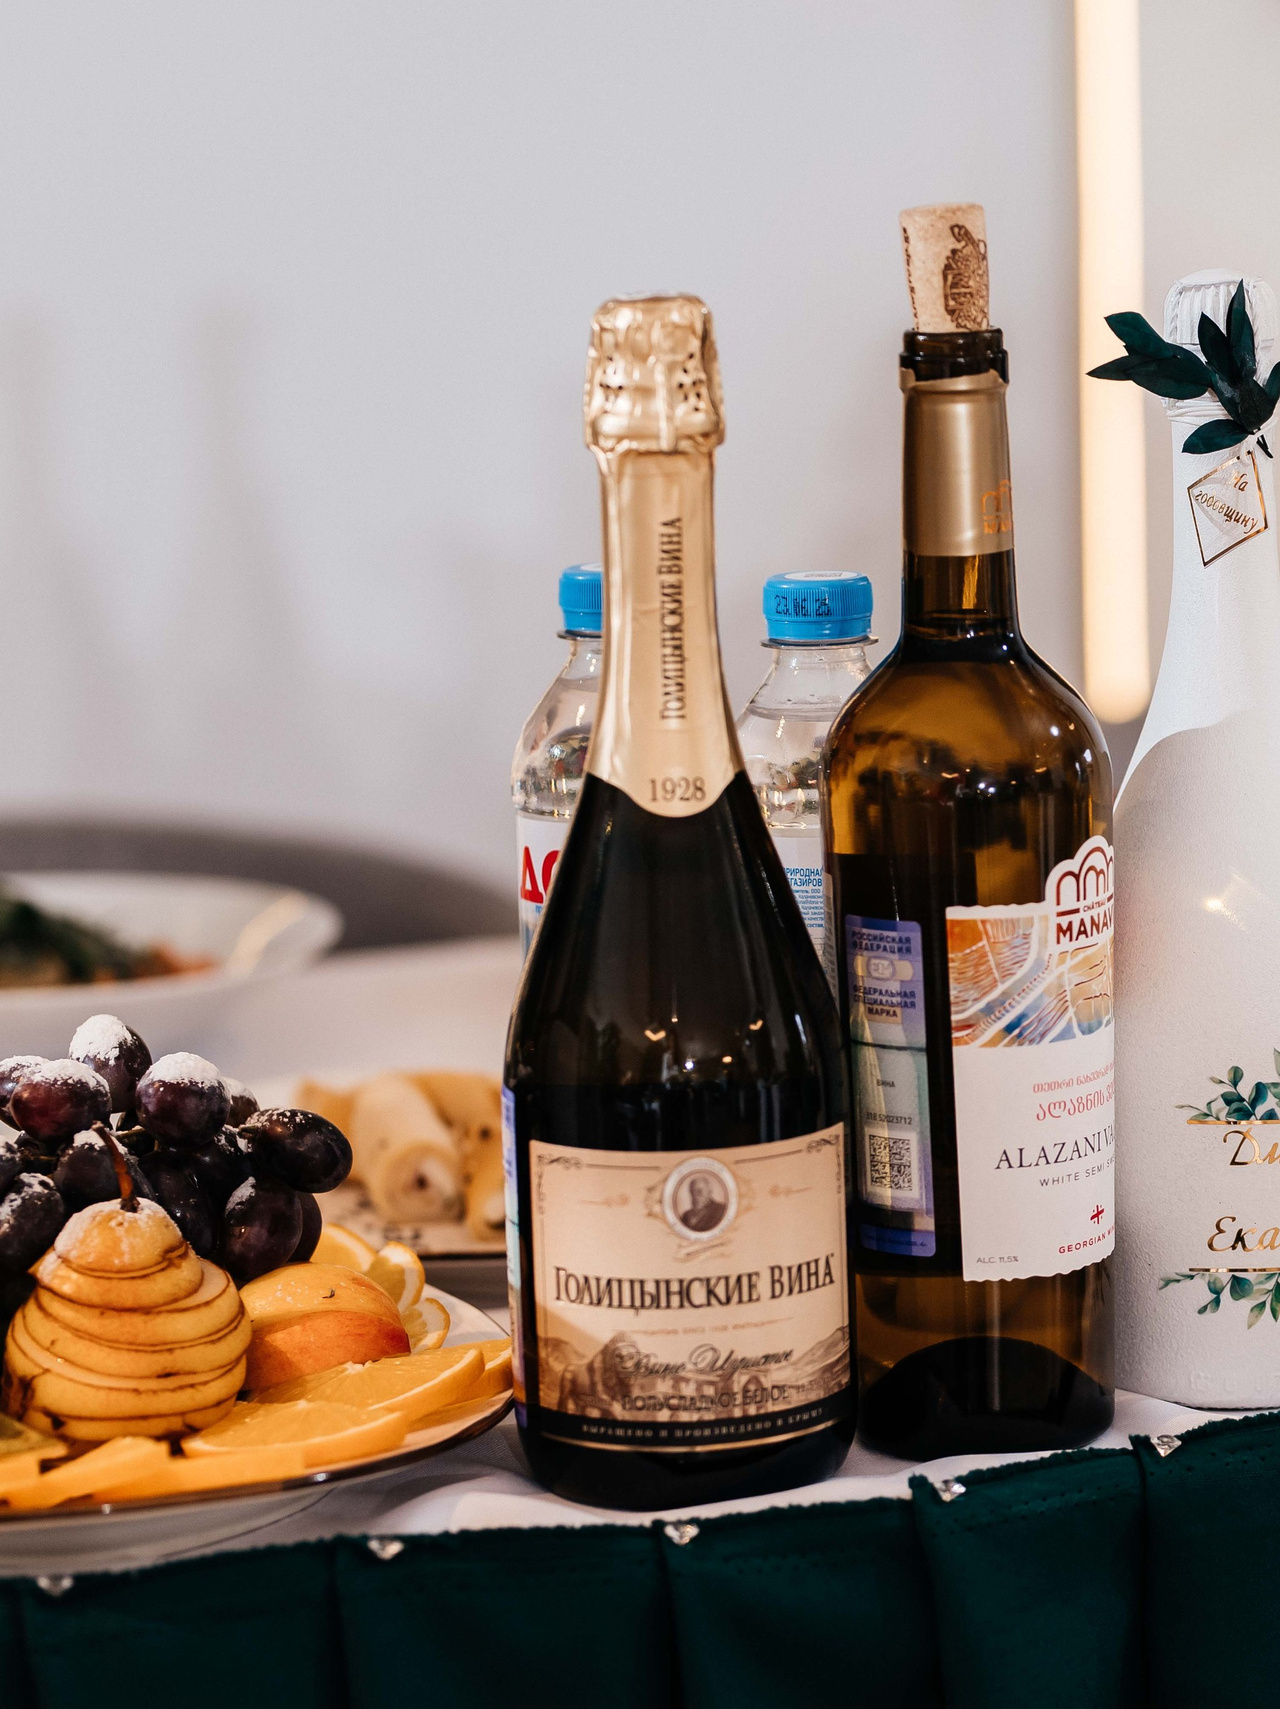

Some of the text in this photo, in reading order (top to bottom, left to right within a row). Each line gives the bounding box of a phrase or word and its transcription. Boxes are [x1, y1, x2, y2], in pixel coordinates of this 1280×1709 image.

[1226, 469, 1248, 492] На
[1194, 489, 1258, 534] годовщину
[650, 776, 707, 802] 1928
[851, 931, 912, 945] РОССИЙСКАЯ
[851, 940, 912, 955] ФЕДЕРАЦИЯ
[853, 984, 916, 999] ФЕДЕРАЛЬНАЯ
[854, 994, 917, 1009] СПЕЦИАЛЬНАЯ
[868, 1006, 898, 1018] МАРКА
[1036, 1089, 1105, 1121] ალაზნის
[994, 1131, 1102, 1170] ALAZANI
[1040, 1171, 1081, 1187] WHITE
[1085, 1162, 1105, 1178] SEMI
[1058, 1232, 1106, 1254] GEORGIAN
[554, 1255, 836, 1317] ГОЛИЦЫНСКИЕ ВИНА
